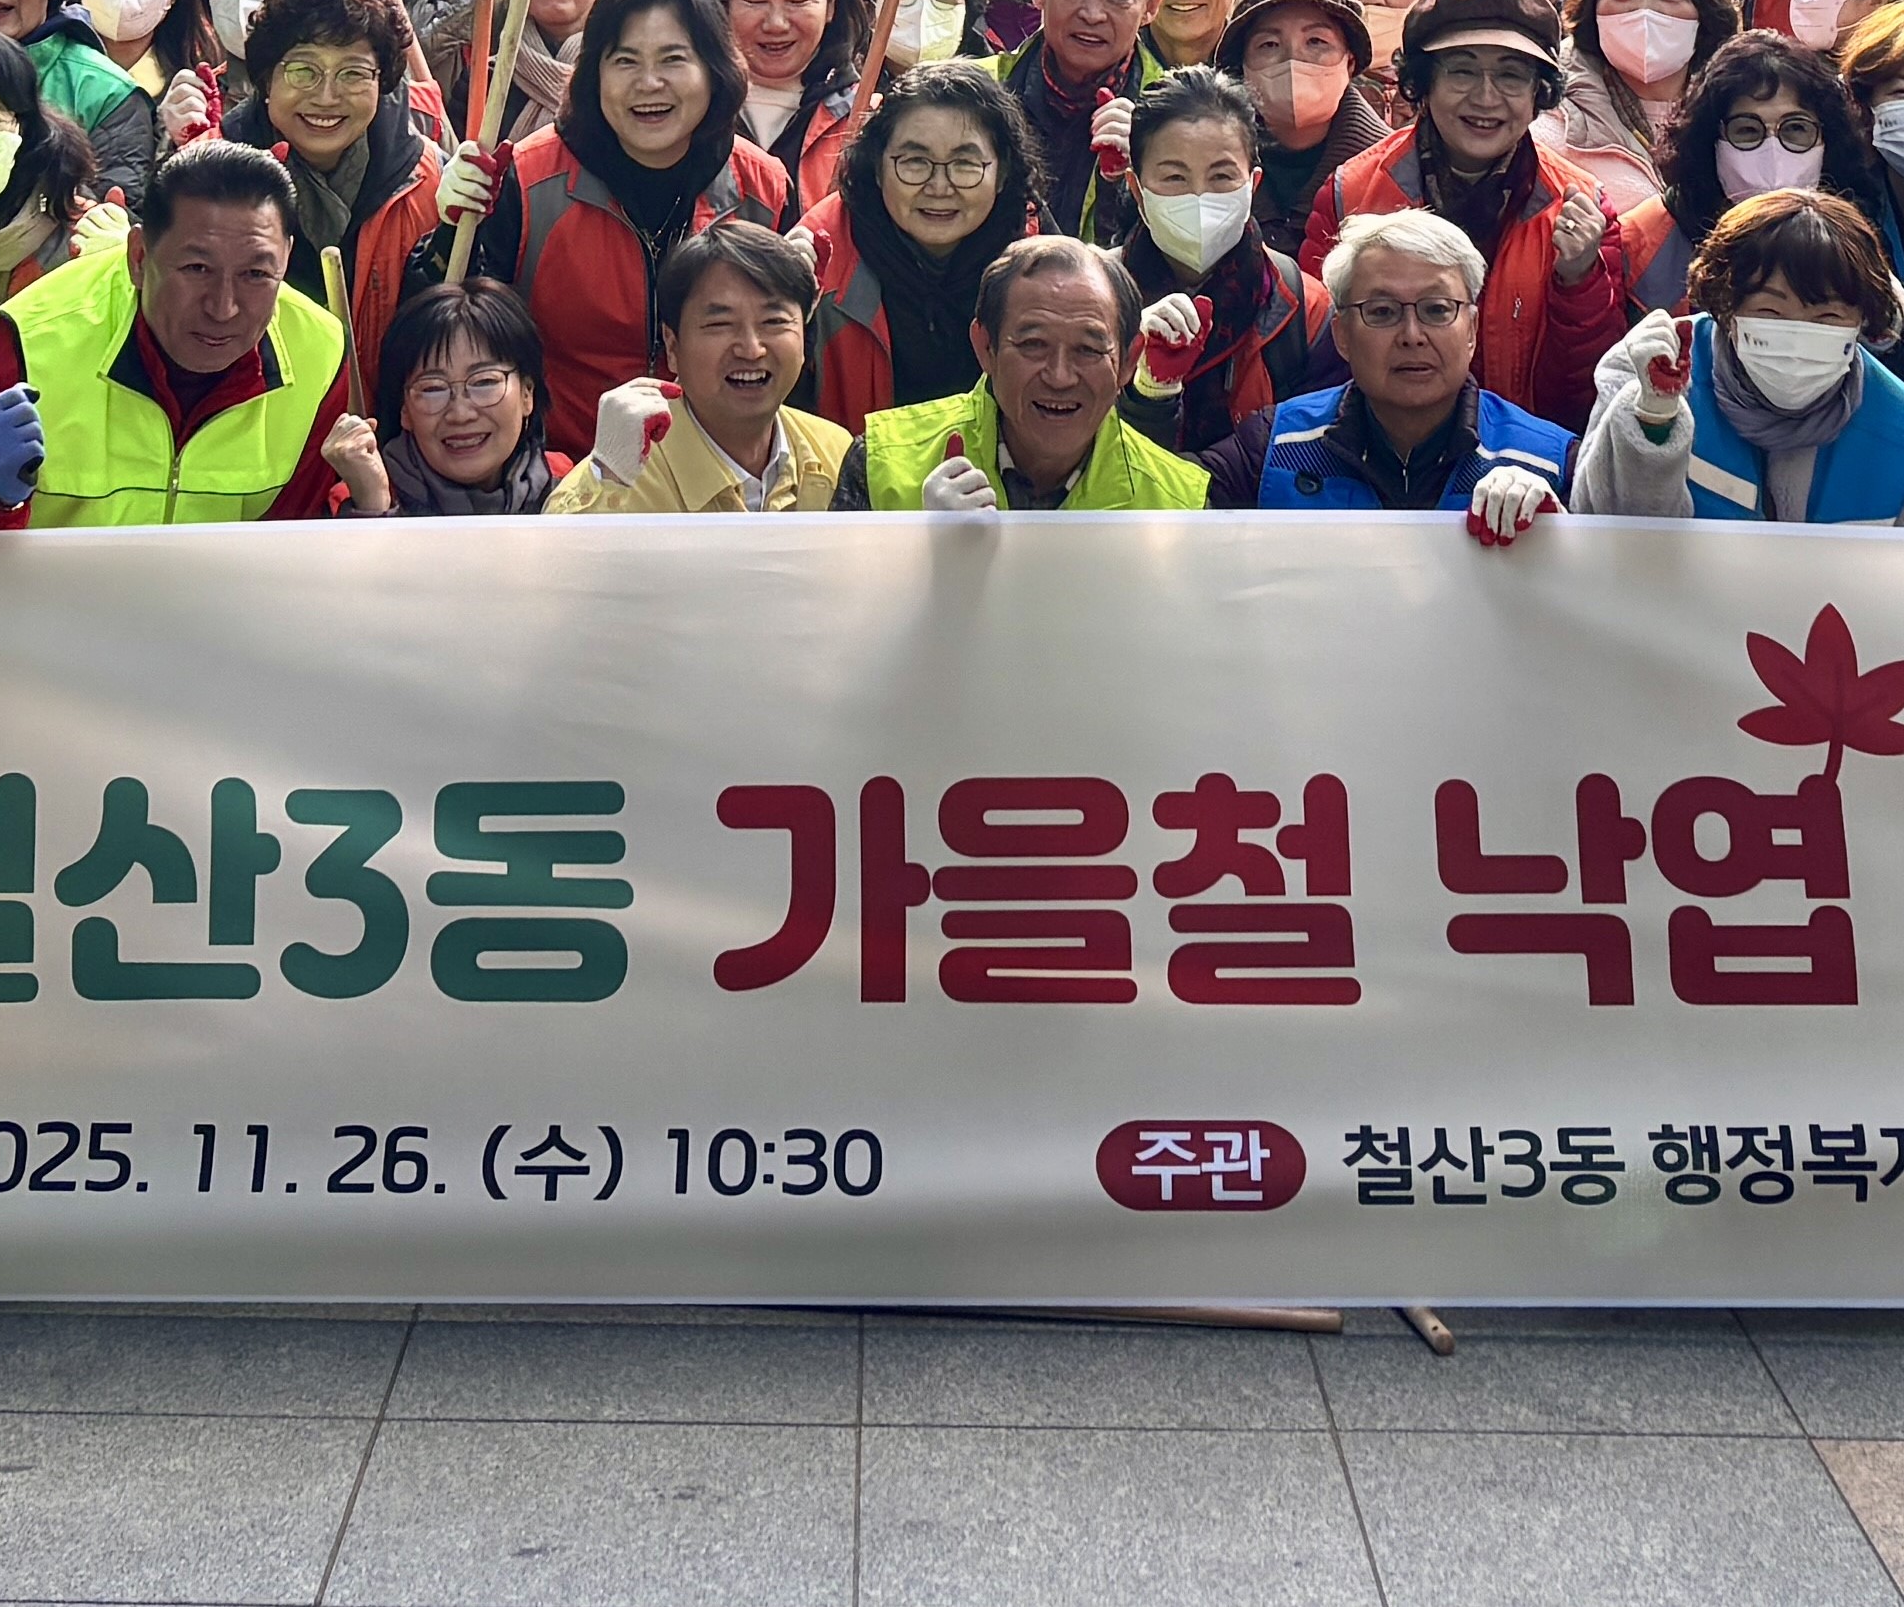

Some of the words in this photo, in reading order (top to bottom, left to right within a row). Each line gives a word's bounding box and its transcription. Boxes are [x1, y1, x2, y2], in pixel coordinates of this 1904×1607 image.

[713, 773, 1362, 1005] 가을철
[1434, 773, 1859, 1006] 낙엽
[193, 1123, 297, 1194] 11.
[326, 1124, 446, 1194] 26.
[482, 1124, 624, 1202] (수)
[667, 1128, 883, 1197] 10:30
[1131, 1129, 1271, 1201] 주관
[1342, 1124, 1626, 1206] 철산3동
